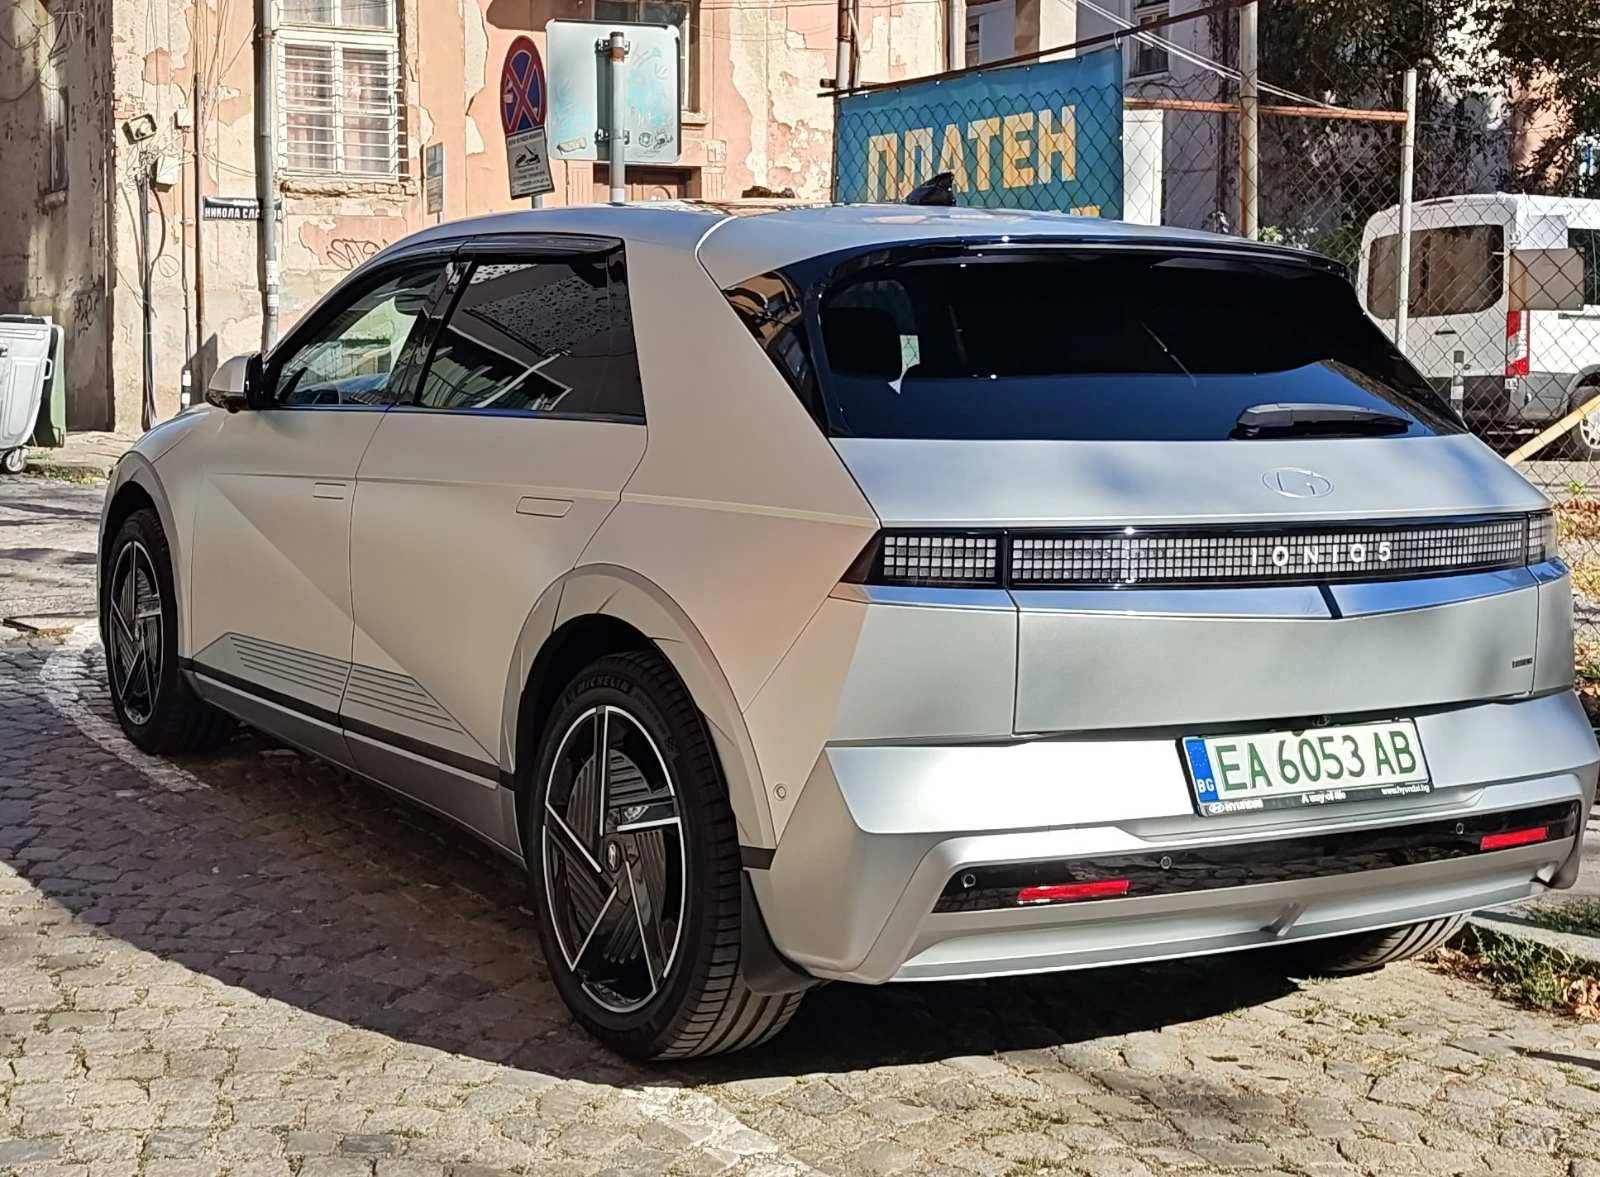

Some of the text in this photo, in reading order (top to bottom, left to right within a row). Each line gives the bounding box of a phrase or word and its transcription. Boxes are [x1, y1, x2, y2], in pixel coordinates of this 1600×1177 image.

[867, 104, 1076, 203] ПЛАТЕН
[205, 207, 240, 219] НИКОЛА
[1251, 541, 1391, 567] IONIQ 5
[1214, 730, 1417, 792] EA 6053 AB
[1196, 778, 1215, 793] BG
